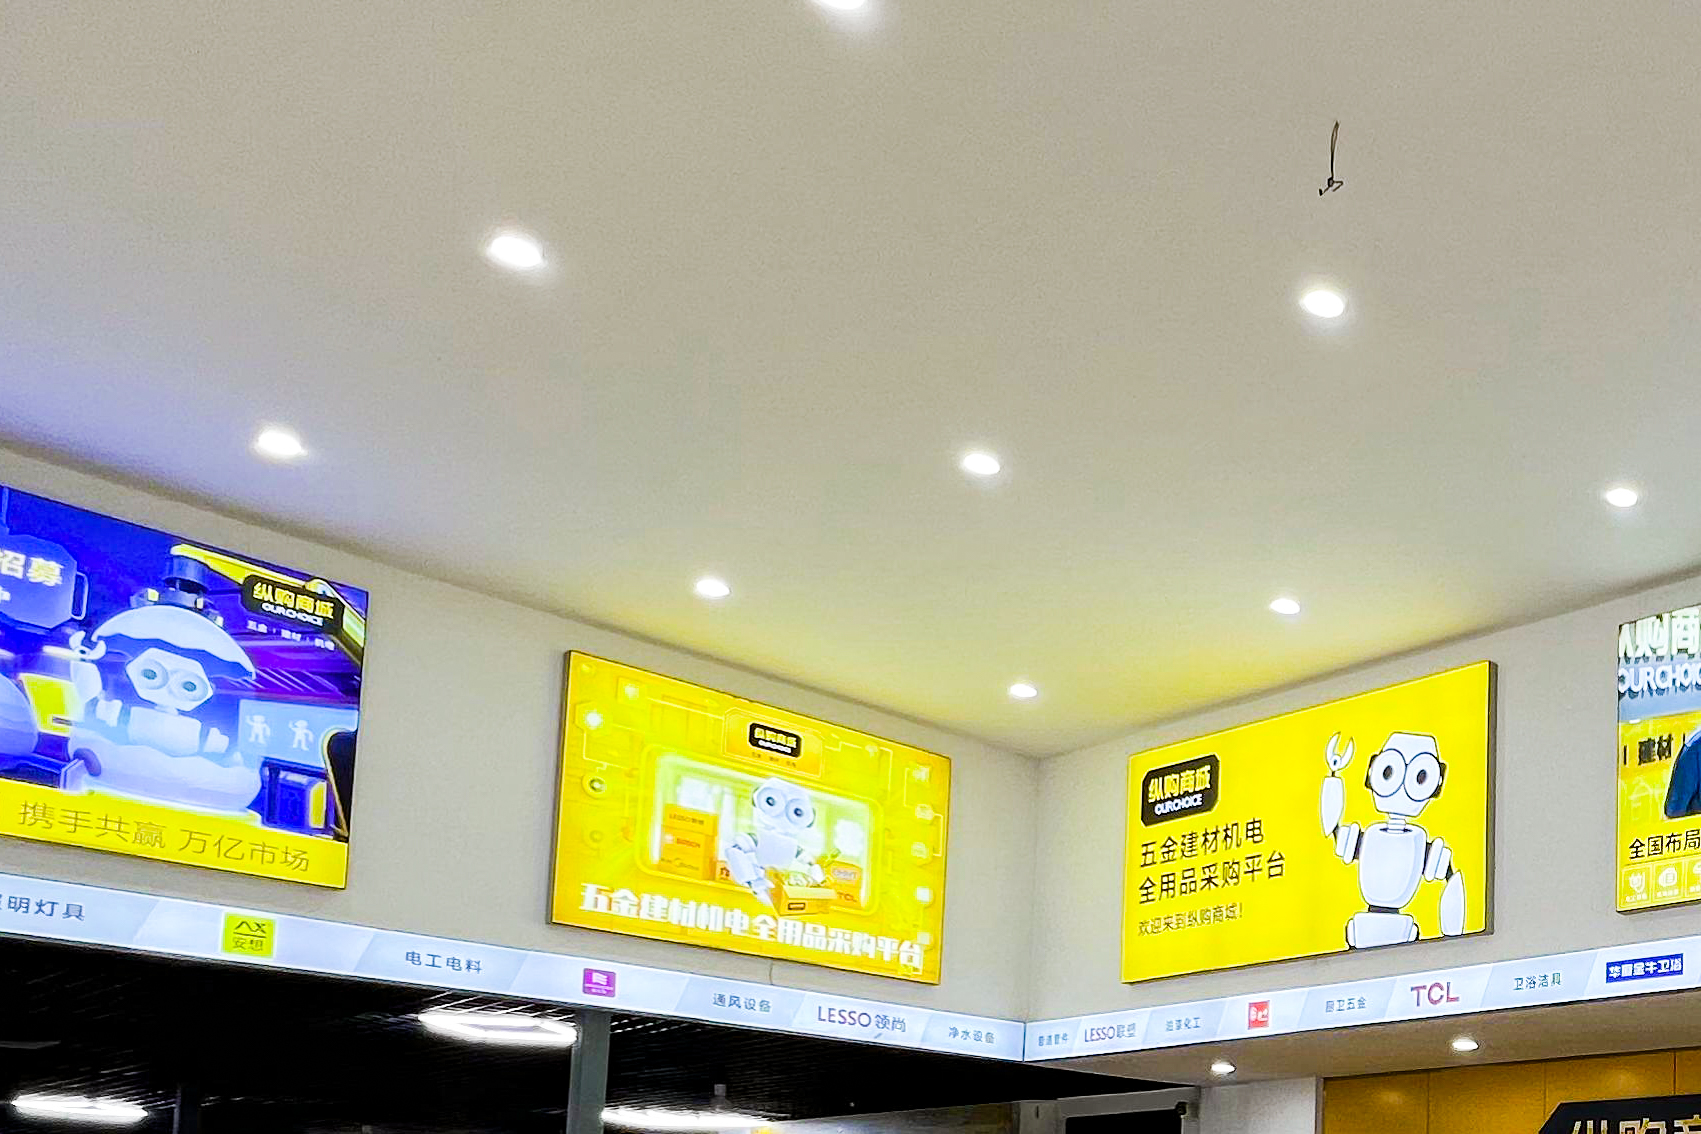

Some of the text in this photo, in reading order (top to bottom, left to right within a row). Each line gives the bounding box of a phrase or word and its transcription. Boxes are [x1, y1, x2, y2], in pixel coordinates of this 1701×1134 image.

[1147, 763, 1212, 805] 纵购商城
[18, 799, 310, 873] 携手共赢 万亿市场
[1139, 817, 1265, 869] 五金建材机电
[1138, 850, 1286, 904] 全用品采购平台
[0, 893, 85, 921] 明灯具
[579, 882, 924, 968] 五金建材机电全用品采购平台
[405, 950, 483, 974] 电工电料
[713, 993, 771, 1013] 通风设备
[1411, 982, 1461, 1007] TCL
[817, 1006, 873, 1028] LESSO
